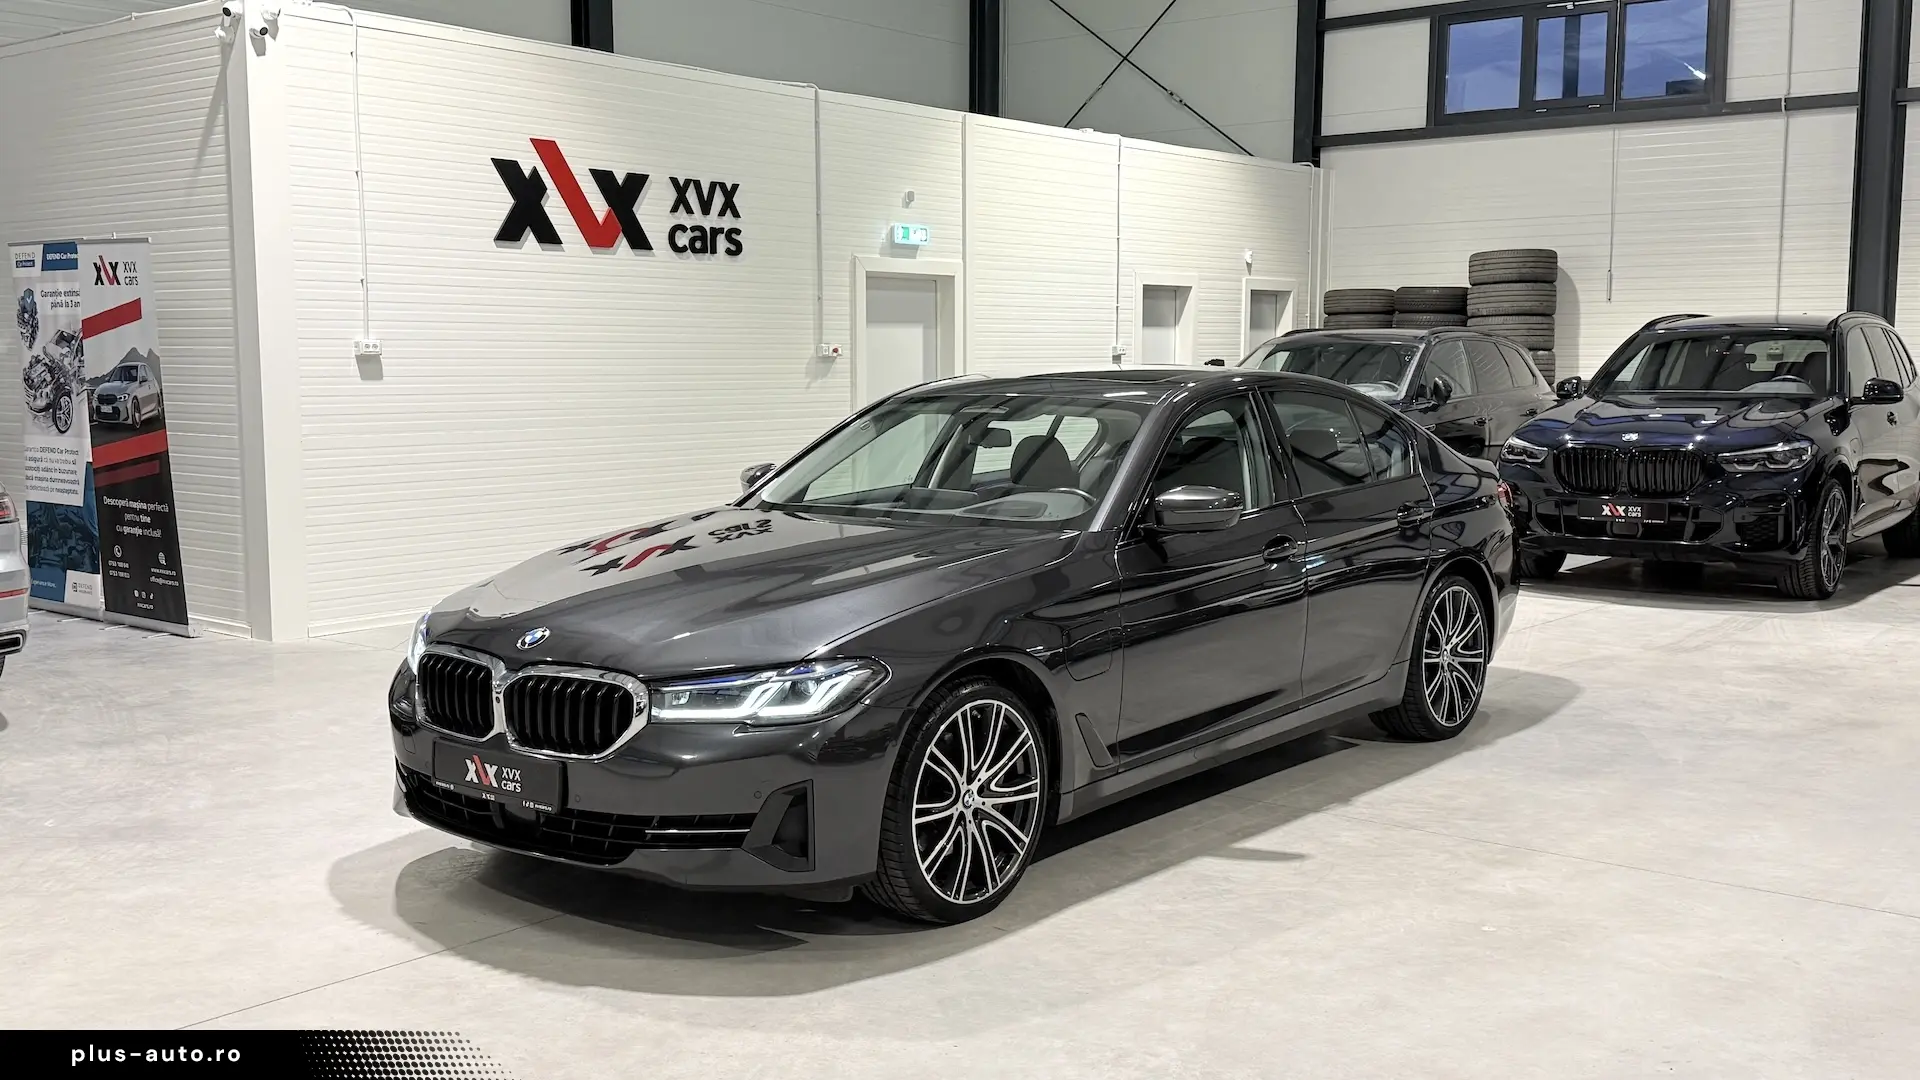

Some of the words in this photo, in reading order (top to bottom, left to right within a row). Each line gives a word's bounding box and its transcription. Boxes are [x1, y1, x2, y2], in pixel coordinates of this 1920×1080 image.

[668, 176, 741, 219] XVX
[668, 223, 744, 257] cars
[15, 252, 36, 260] DEFEND
[122, 261, 138, 273] XVX
[124, 274, 139, 286] cars
[140, 514, 151, 523] tine
[501, 766, 521, 782] XVX
[501, 780, 522, 793] cars
